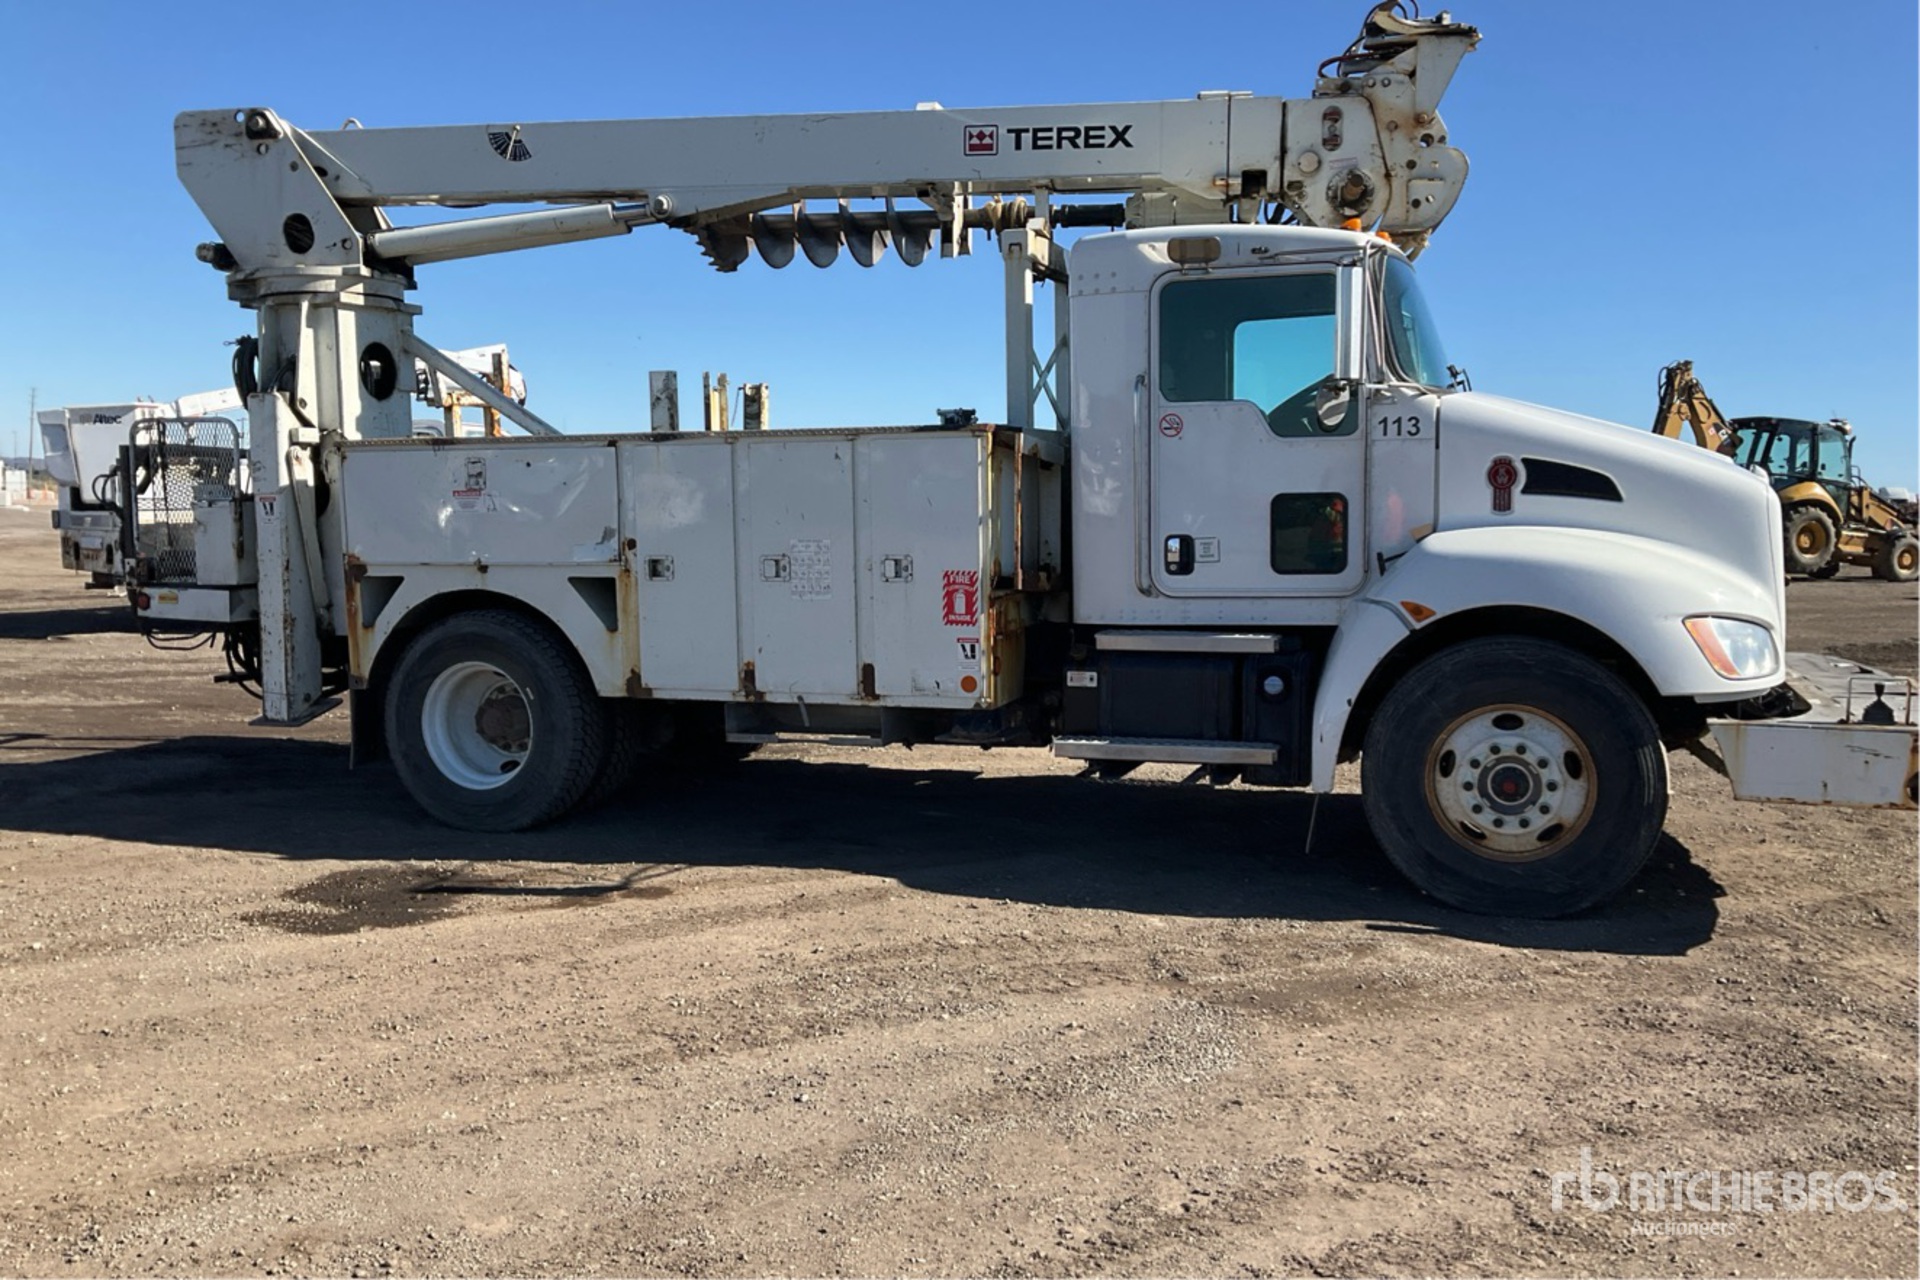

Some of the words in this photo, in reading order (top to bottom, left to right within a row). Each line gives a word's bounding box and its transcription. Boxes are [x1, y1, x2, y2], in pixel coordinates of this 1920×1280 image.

[1006, 124, 1134, 151] TEREX
[1378, 415, 1421, 437] 113
[950, 574, 971, 584] FIRE
